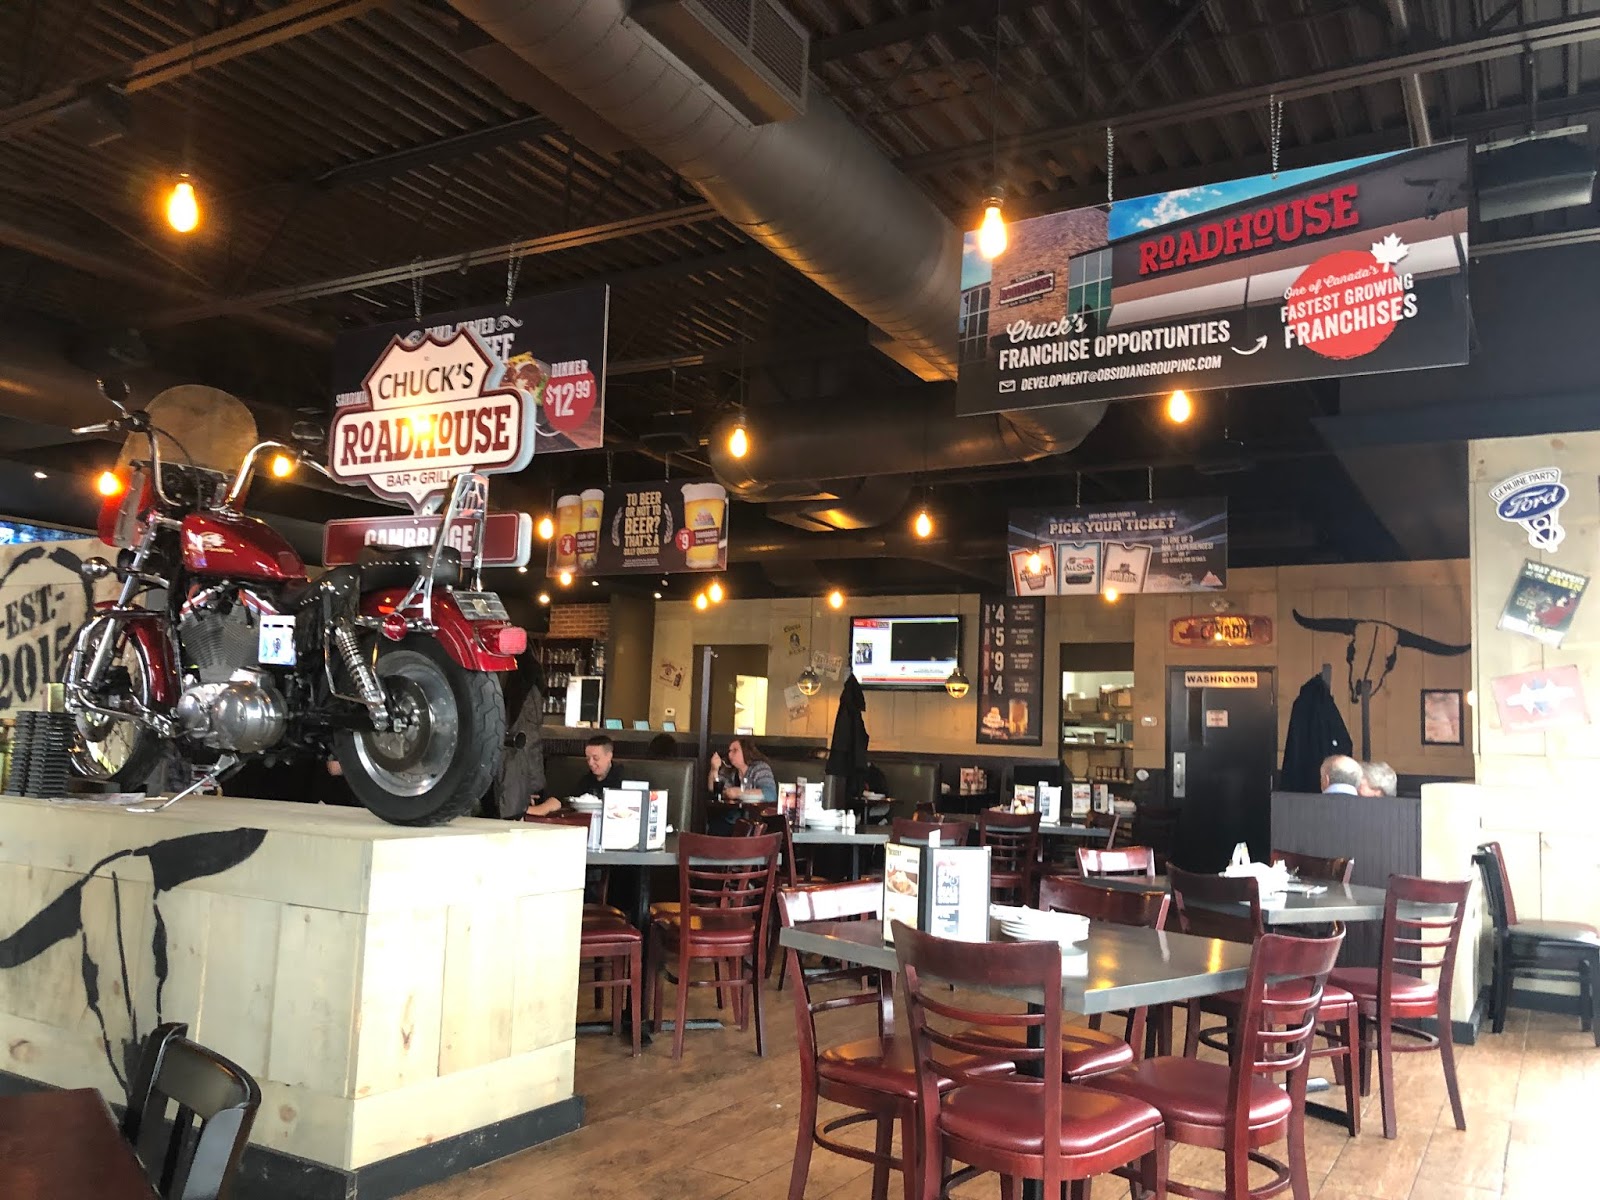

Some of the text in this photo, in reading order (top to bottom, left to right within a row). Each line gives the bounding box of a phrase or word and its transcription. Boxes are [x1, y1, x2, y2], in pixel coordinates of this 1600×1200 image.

[1139, 184, 1359, 275] ROADHOUSE
[1280, 272, 1414, 323] FASTEST GROWING
[1284, 265, 1379, 300] One of Canada's
[1006, 313, 1088, 344] Chuck's
[1284, 293, 1418, 349] FRANCHISES
[999, 319, 1231, 371] FRANCHISE OPPORTUNTIES
[377, 362, 474, 400] CHUCK'S
[1021, 355, 1222, 391] DEVELOPMENT@OBSIDIANGROUPINC.COM
[340, 405, 511, 466] ROADHOUSE
[386, 474, 411, 487] BAR
[1494, 471, 1556, 498] GENUINE PARTS
[626, 491, 662, 506] TO BEER
[1504, 486, 1559, 517] Ford
[364, 524, 474, 553] CAMBRIGE
[624, 516, 661, 535] BEER?
[624, 534, 660, 547] THAT'S A
[1049, 517, 1176, 535] PICK YOUR TICKET
[1187, 675, 1256, 684] WASHROOMS
